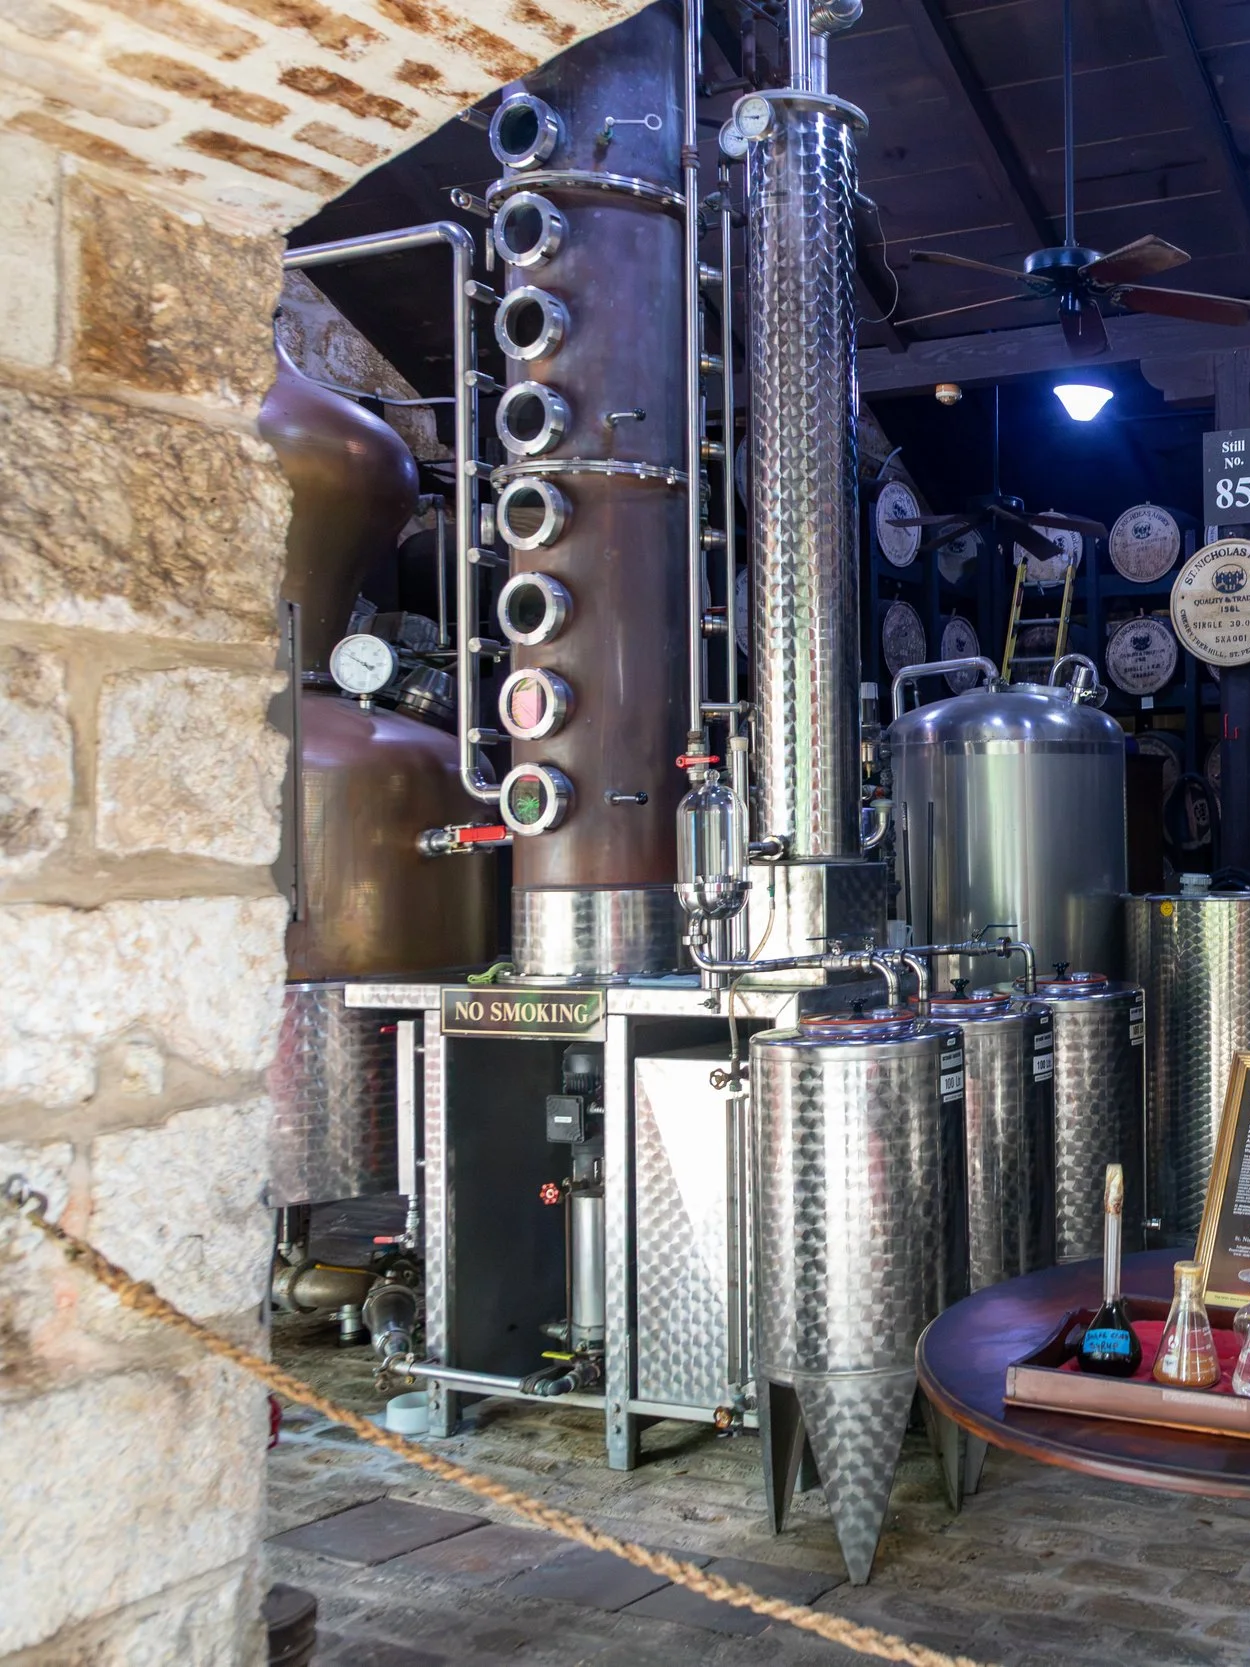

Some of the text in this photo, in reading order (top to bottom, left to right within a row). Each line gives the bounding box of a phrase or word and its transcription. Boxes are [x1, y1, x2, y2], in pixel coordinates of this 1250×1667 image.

[1222, 440, 1245, 453] Still
[1224, 457, 1244, 469] No.
[1184, 570, 1197, 586] ST.
[1195, 547, 1248, 571] NICHOLAS
[1193, 597, 1223, 607] QUALITY
[455, 1001, 588, 1024] NO SMOKING
[945, 1077, 954, 1090] 100
